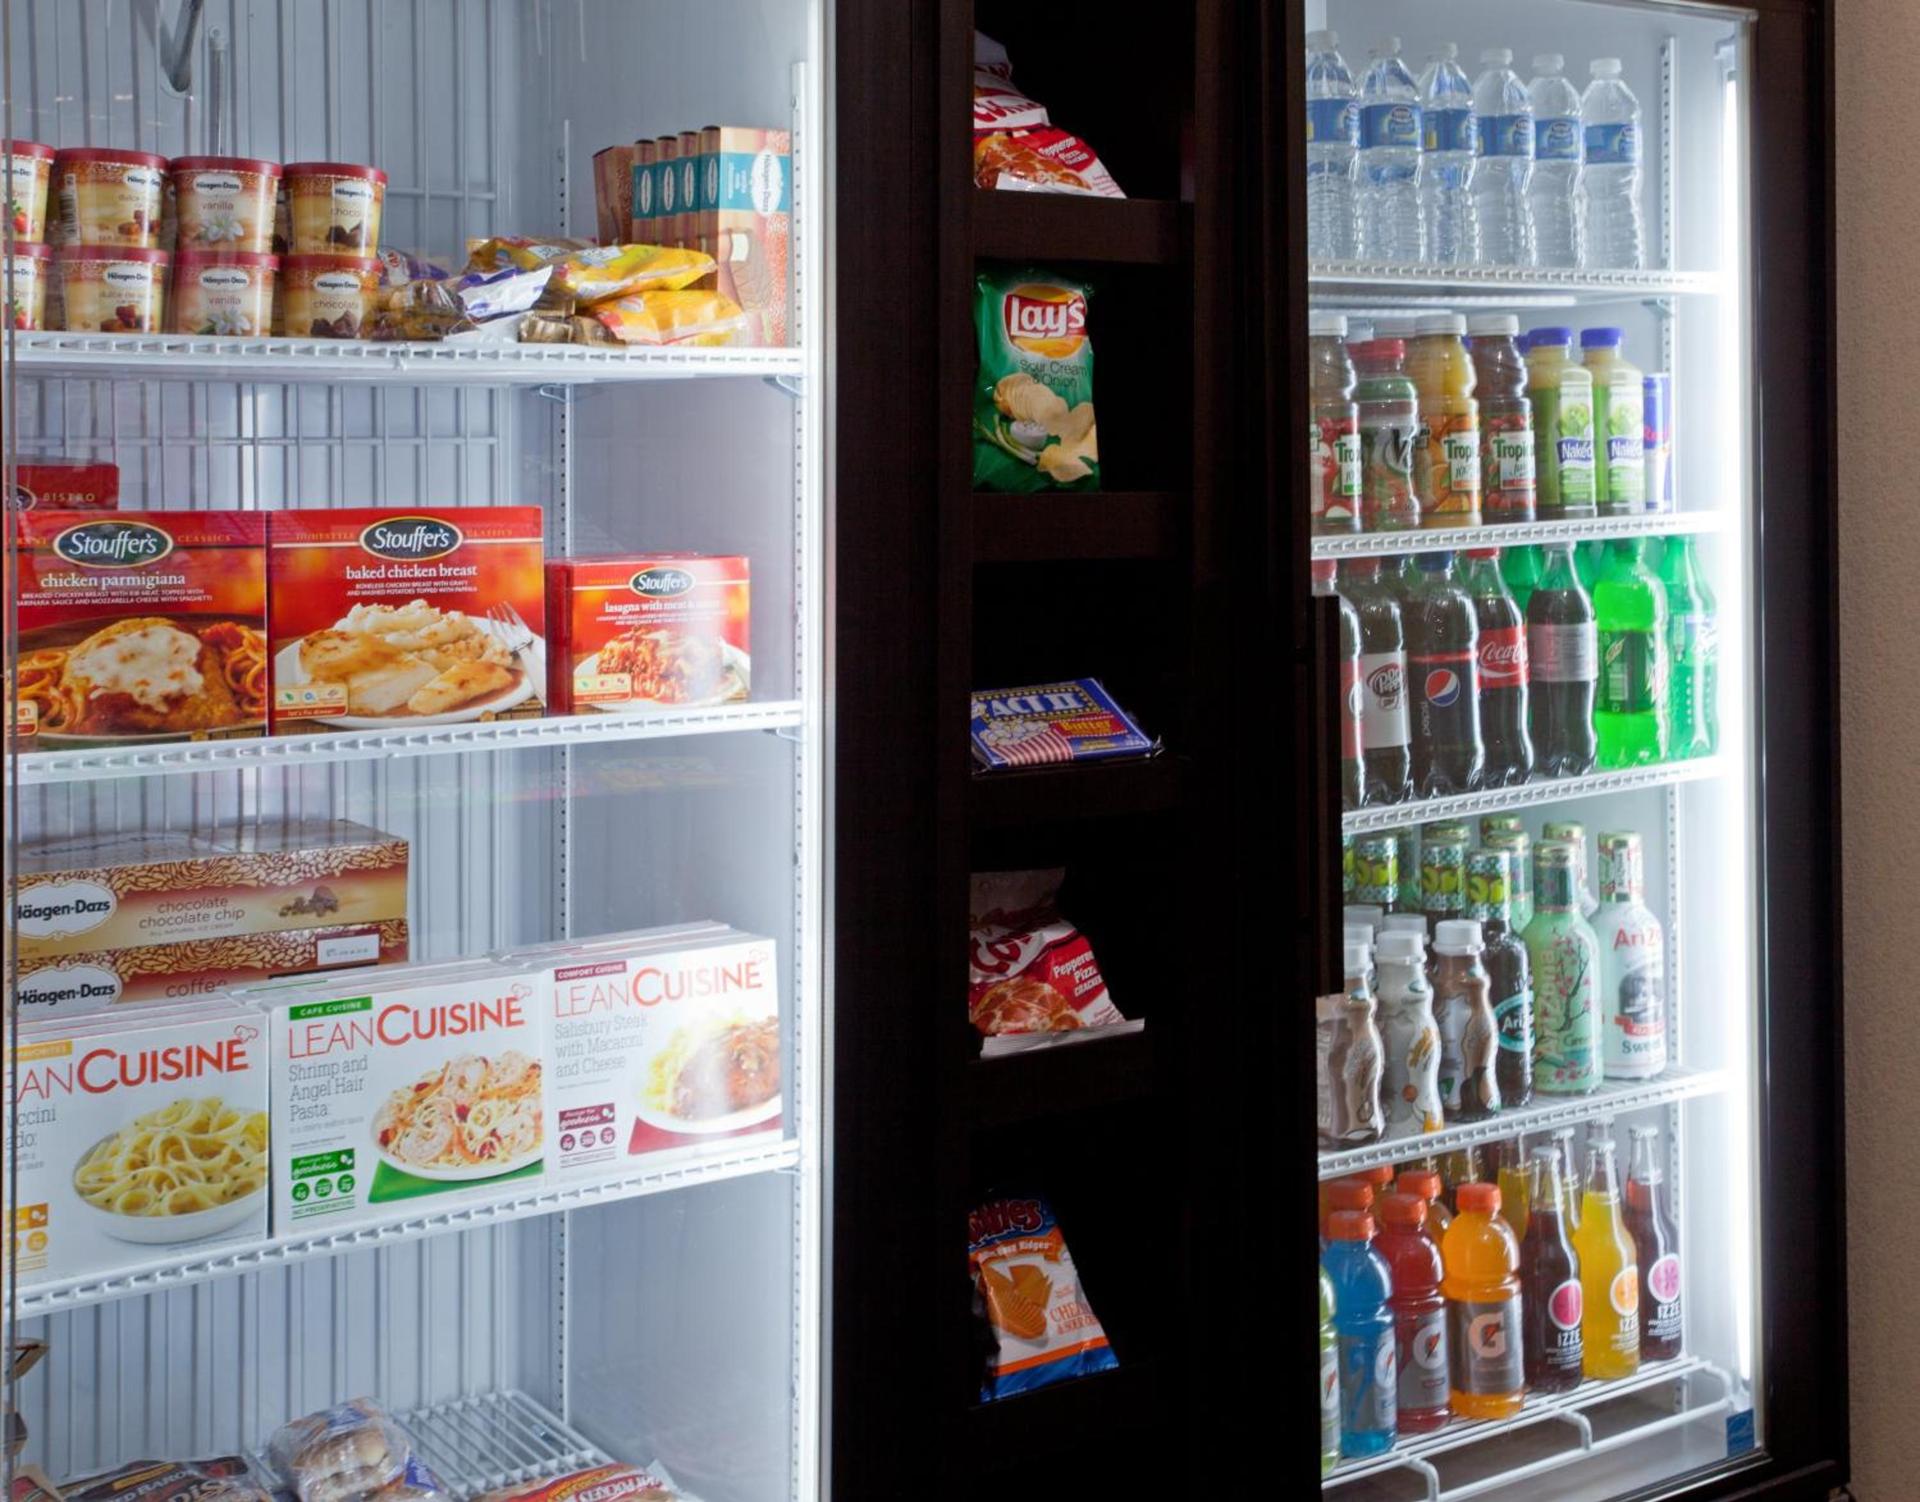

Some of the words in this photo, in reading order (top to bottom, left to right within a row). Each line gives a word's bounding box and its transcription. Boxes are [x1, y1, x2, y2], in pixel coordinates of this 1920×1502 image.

[201, 201, 234, 211] vanilla
[208, 296, 241, 306] vanilla
[1010, 295, 1085, 338] Lay's
[1019, 359, 1047, 373] Sour
[1050, 361, 1087, 377] Cream
[1561, 441, 1593, 459] Naked
[43, 492, 96, 502] BISTRO
[68, 530, 158, 560] Stouffer's
[372, 525, 450, 553] Stouffer's
[41, 572, 98, 588] chicken
[101, 570, 185, 591] parmigiana
[346, 564, 385, 580] baked
[387, 563, 437, 579] chicken
[438, 562, 478, 577] breast
[637, 572, 688, 593] Stouffer's
[605, 601, 640, 615] lasagna
[641, 599, 663, 612] with
[990, 695, 1042, 717] ACT
[1060, 720, 1112, 733] Butter
[157, 896, 229, 914] chocolate
[138, 911, 211, 929] chocolate
[214, 907, 245, 921] chip
[17, 983, 117, 1006] Häagen-Dazs
[554, 976, 630, 1018] LEAN
[631, 961, 763, 1007] CUISINE
[300, 1007, 323, 1017] CAFE
[326, 1001, 362, 1013] CUISINE
[288, 1016, 374, 1060] LEAN
[376, 996, 526, 1047] CUISINE
[554, 1040, 585, 1059] with
[76, 1038, 251, 1094] CUISINE
[288, 1061, 341, 1083] Shrimp
[341, 1053, 369, 1074] and
[555, 1060, 580, 1079] and
[288, 1081, 333, 1103] Angel
[334, 1076, 365, 1096] Hair
[289, 1103, 329, 1122] Pasta
[1468, 1311, 1507, 1359] G
[1558, 1328, 1581, 1347] IZZE
